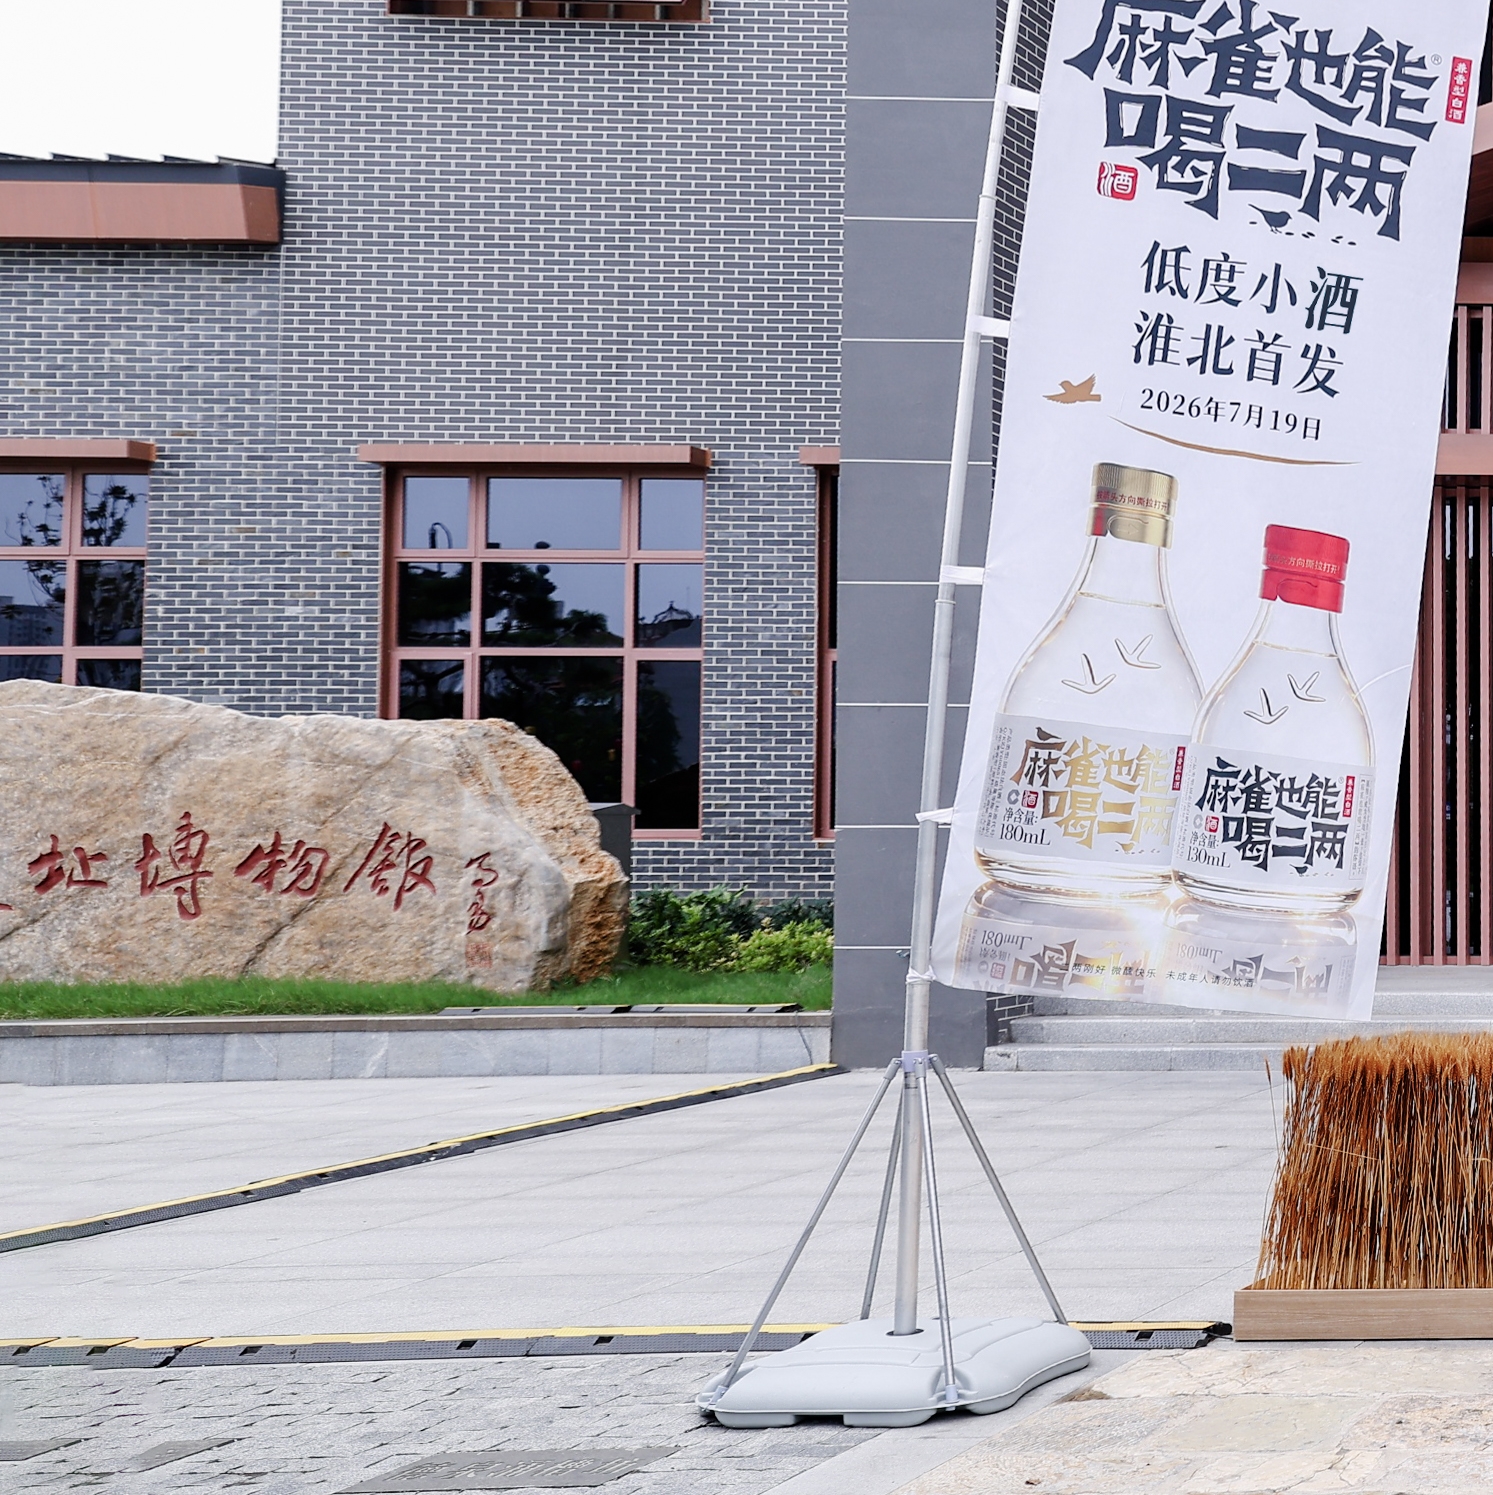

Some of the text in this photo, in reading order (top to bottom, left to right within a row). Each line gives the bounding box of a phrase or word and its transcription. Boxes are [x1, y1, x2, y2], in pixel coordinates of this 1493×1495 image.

[1447, 60, 1471, 122] 兼香型白酒
[1103, 87, 1417, 242] 喝二两
[1140, 240, 1364, 334] 低度小酒
[1132, 310, 1343, 398] 淮北首发
[1140, 387, 1321, 441] 2026年7月19日
[1010, 727, 1172, 795] 麻雀也能
[1195, 757, 1342, 821] 麻雀也能
[1000, 824, 1051, 846] 180mL
[1041, 790, 1177, 850] 喝二两
[1222, 815, 1349, 872] 喝二两
[1187, 846, 1231, 869] 130mL
[1165, 969, 1256, 989] 未成年人请勿饮酒
